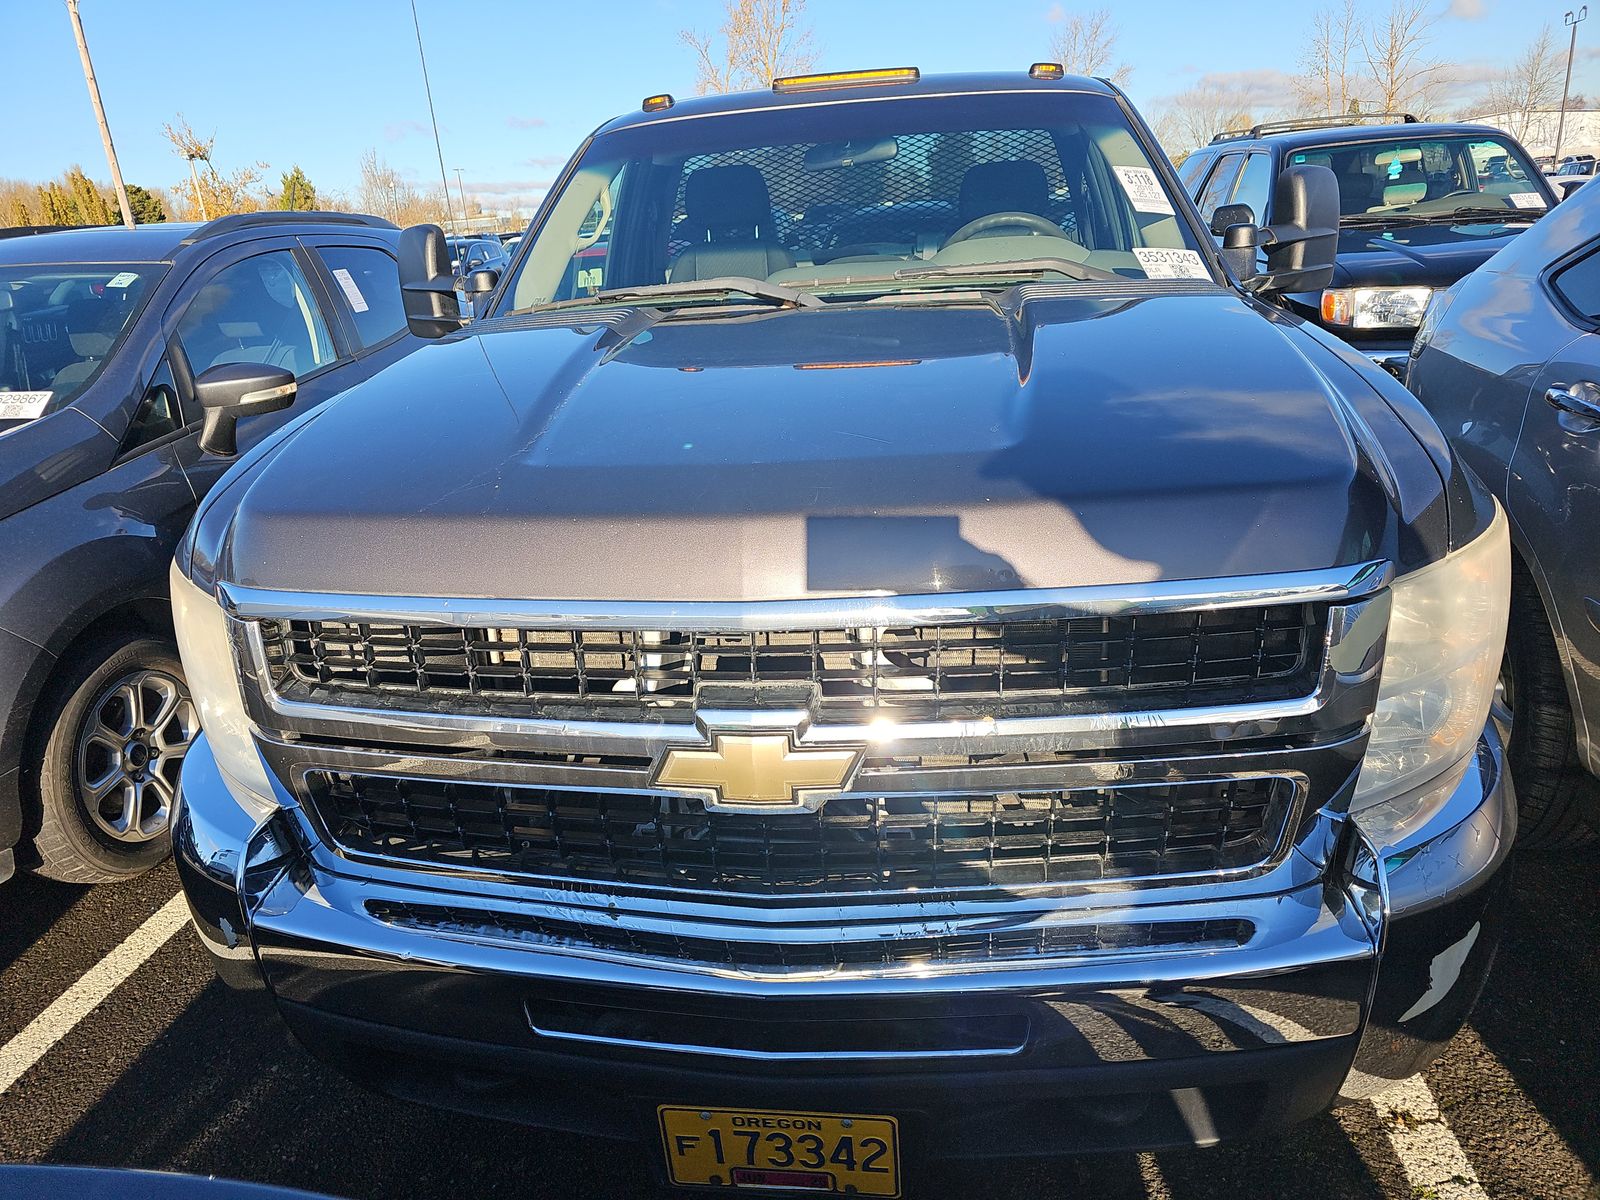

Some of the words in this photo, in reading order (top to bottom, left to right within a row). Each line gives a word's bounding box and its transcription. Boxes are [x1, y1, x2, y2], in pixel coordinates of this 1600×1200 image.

[1138, 251, 1200, 266] 3531343
[731, 1116, 823, 1131] OREGON
[674, 1129, 889, 1174] F173342
